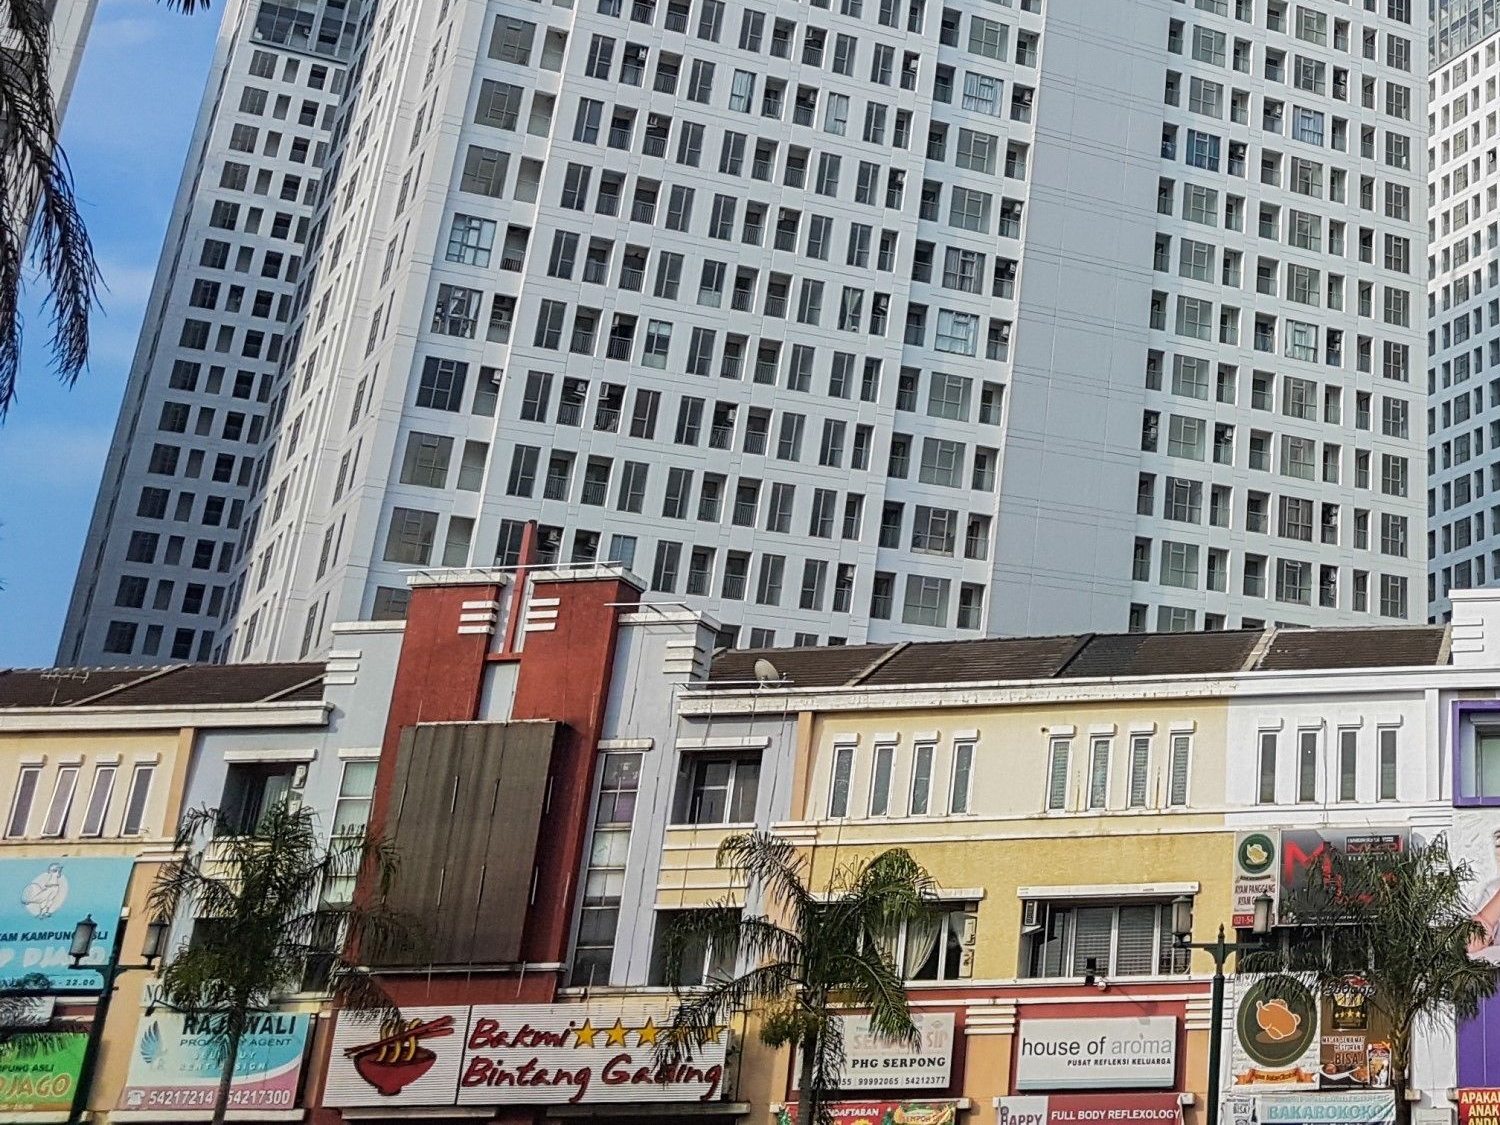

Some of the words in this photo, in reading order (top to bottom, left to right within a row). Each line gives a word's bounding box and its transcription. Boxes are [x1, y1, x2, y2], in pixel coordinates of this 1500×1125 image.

[467, 1017, 576, 1049] Bakmi
[1021, 1037, 1081, 1056] house
[1087, 1036, 1107, 1055] of
[1111, 1038, 1172, 1055] aroma
[851, 1058, 879, 1068] PHG
[882, 1057, 946, 1069] SERPONG
[461, 1055, 592, 1103] Bintang
[601, 1053, 723, 1101] Gading
[858, 1077, 899, 1086] 99992065
[905, 1076, 946, 1085] 54212377
[149, 1090, 214, 1105] 54217214
[1051, 1110, 1076, 1121] FULL
[1078, 1110, 1106, 1120] BODY
[1108, 1109, 1181, 1120] REFLEXOLOGY
[1468, 1104, 1500, 1117] ANAK
